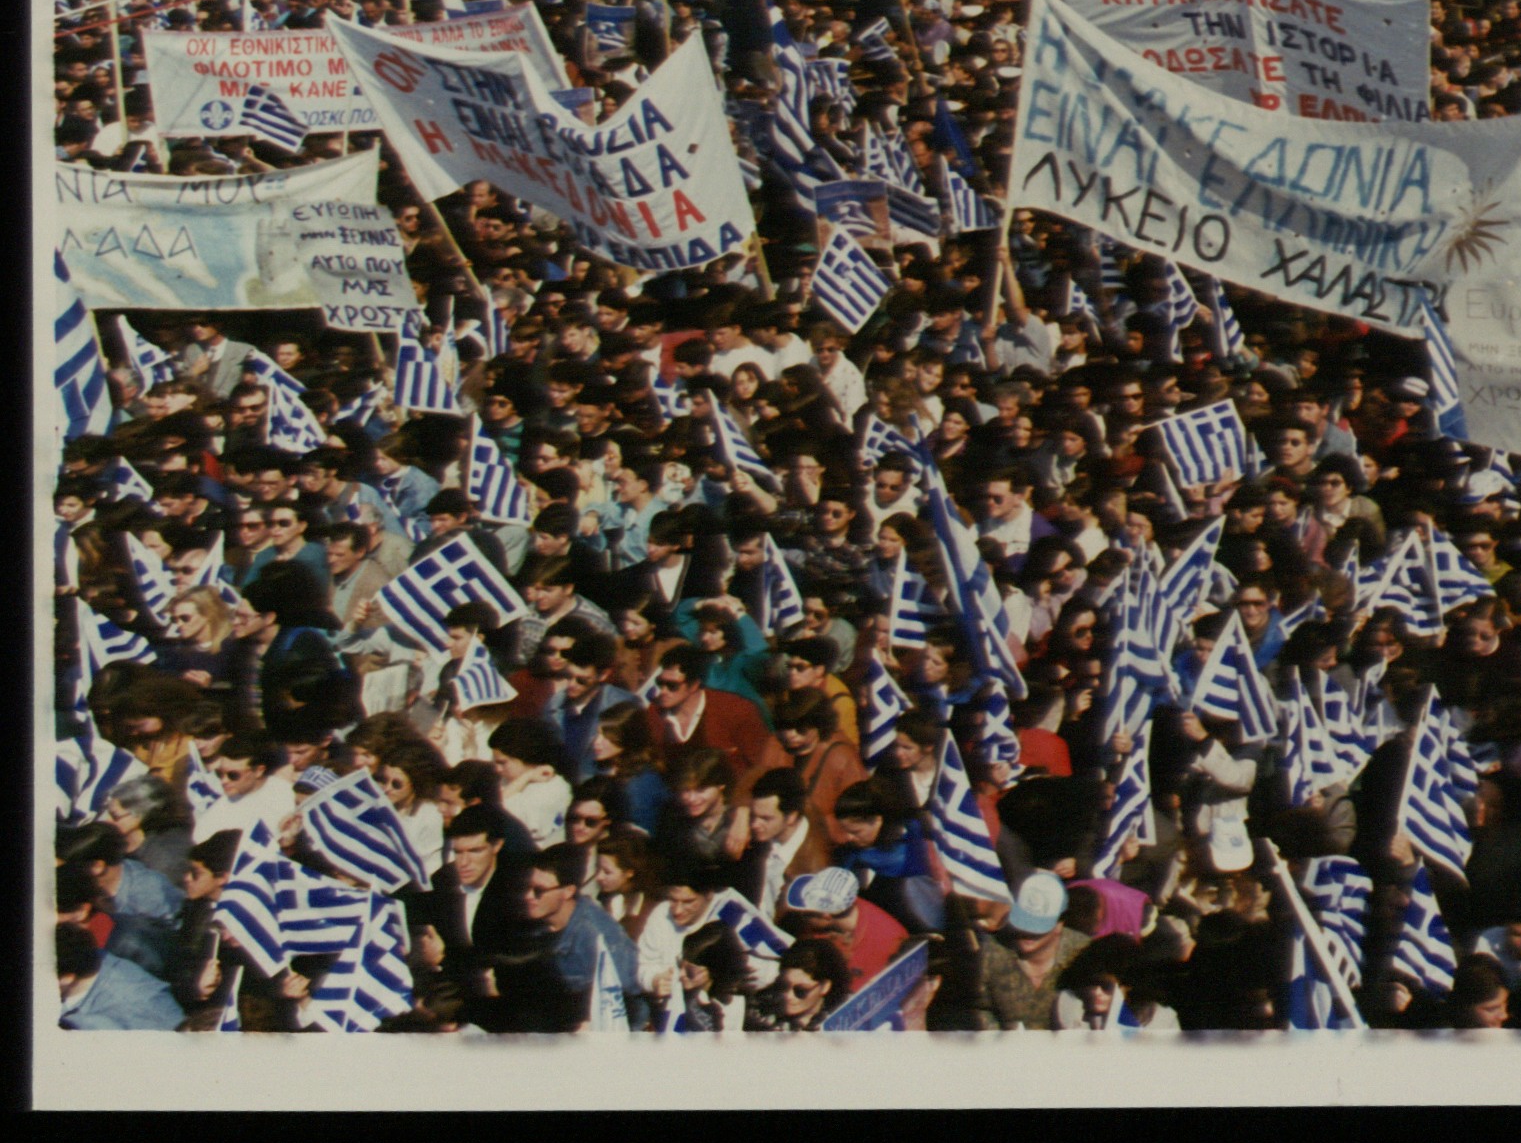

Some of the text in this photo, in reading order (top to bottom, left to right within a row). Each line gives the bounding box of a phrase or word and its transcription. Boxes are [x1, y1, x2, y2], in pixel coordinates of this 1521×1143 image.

[1183, 11, 1246, 39] ΤΗΝ
[186, 38, 217, 56] ΟΧΙ
[193, 58, 313, 80] ΦΙΛΟΤΙΜΟ
[1300, 62, 1343, 94] ΤΗ
[1356, 83, 1432, 124] ΦΙΛΙΑ
[413, 118, 454, 155] Η
[1022, 151, 1231, 262] ΛΥΚΕΙΟ
[60, 223, 199, 260] ΛΑΔΑ
[311, 254, 404, 275] ΑΥΤΟ ΠΟΥ
[341, 279, 395, 297] ΜΑΣ
